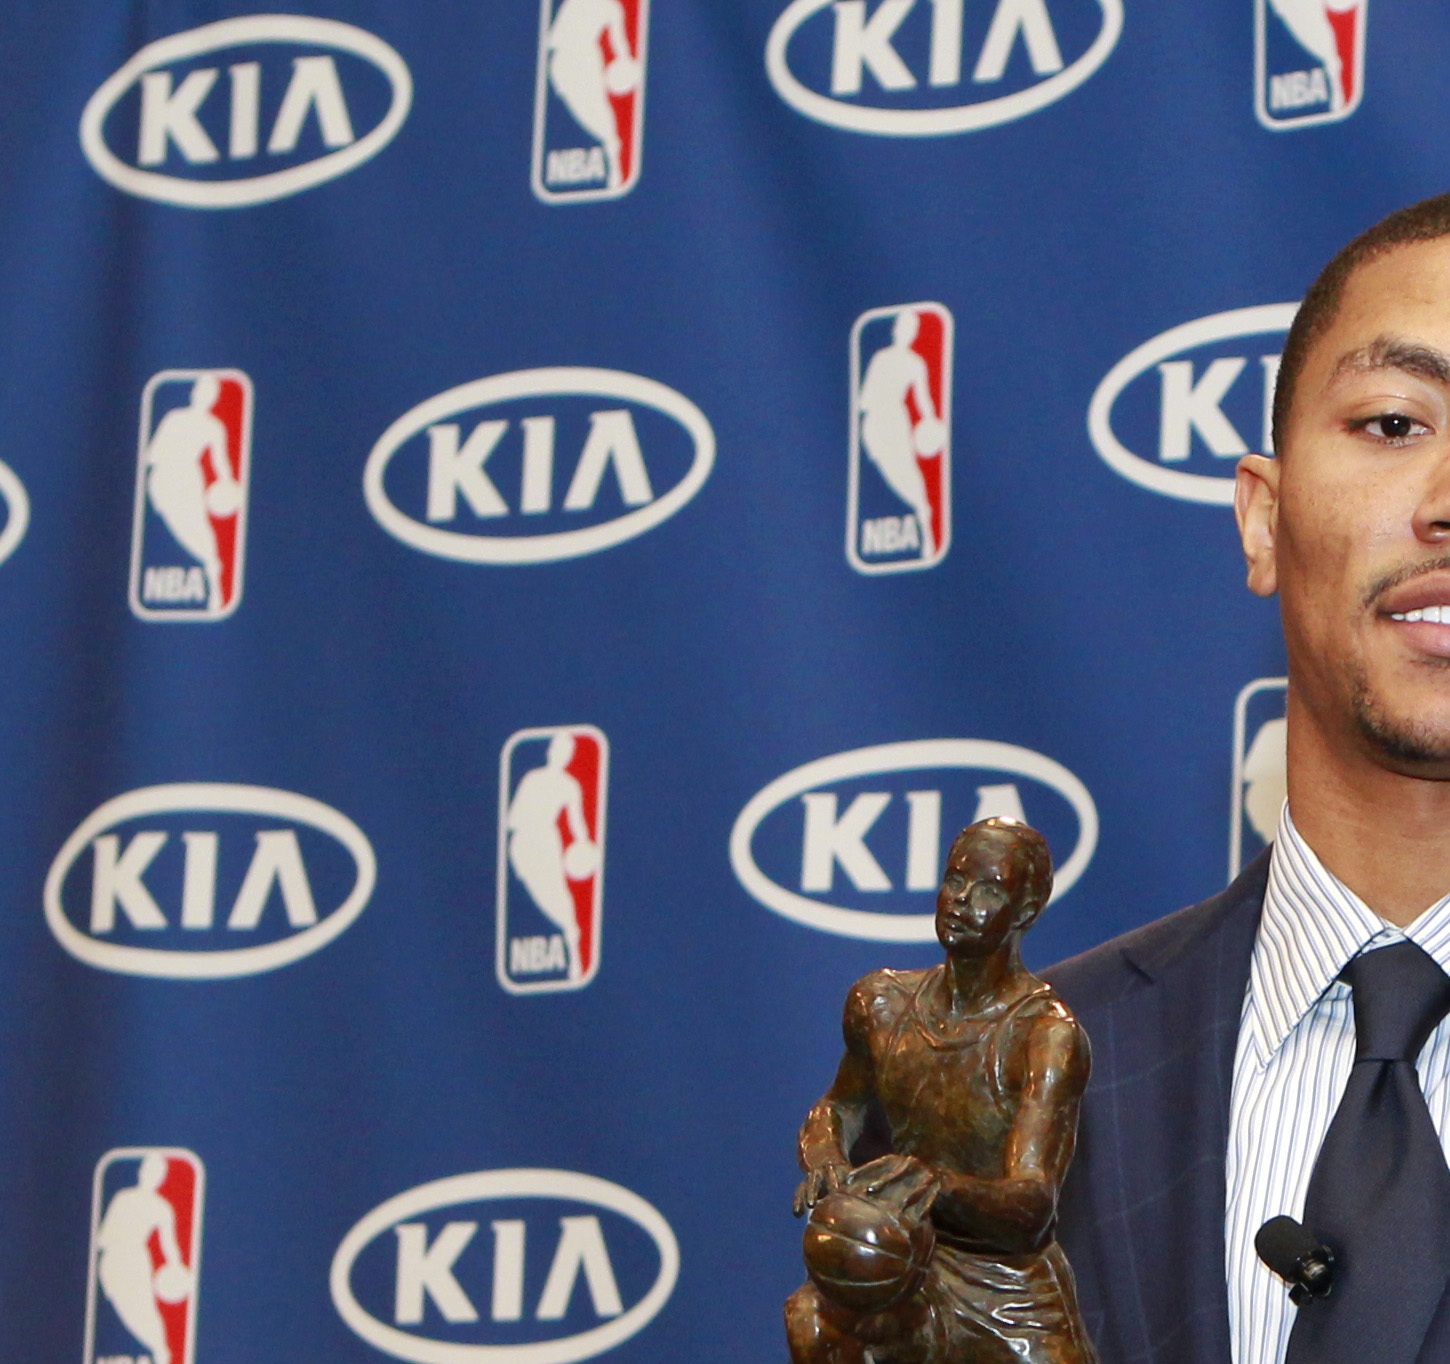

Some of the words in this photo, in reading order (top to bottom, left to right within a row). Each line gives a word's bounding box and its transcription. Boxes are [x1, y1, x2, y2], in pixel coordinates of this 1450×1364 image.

[832, 0, 1064, 95] KIA
[138, 56, 354, 166] KIA
[1270, 67, 1328, 109] NBA
[546, 147, 606, 184] NBA
[427, 410, 653, 521] KIA
[862, 514, 919, 554] NBA
[143, 566, 206, 600] NBA
[90, 830, 317, 933] KIA
[510, 936, 567, 973] NBA
[395, 1216, 623, 1324] KIA
